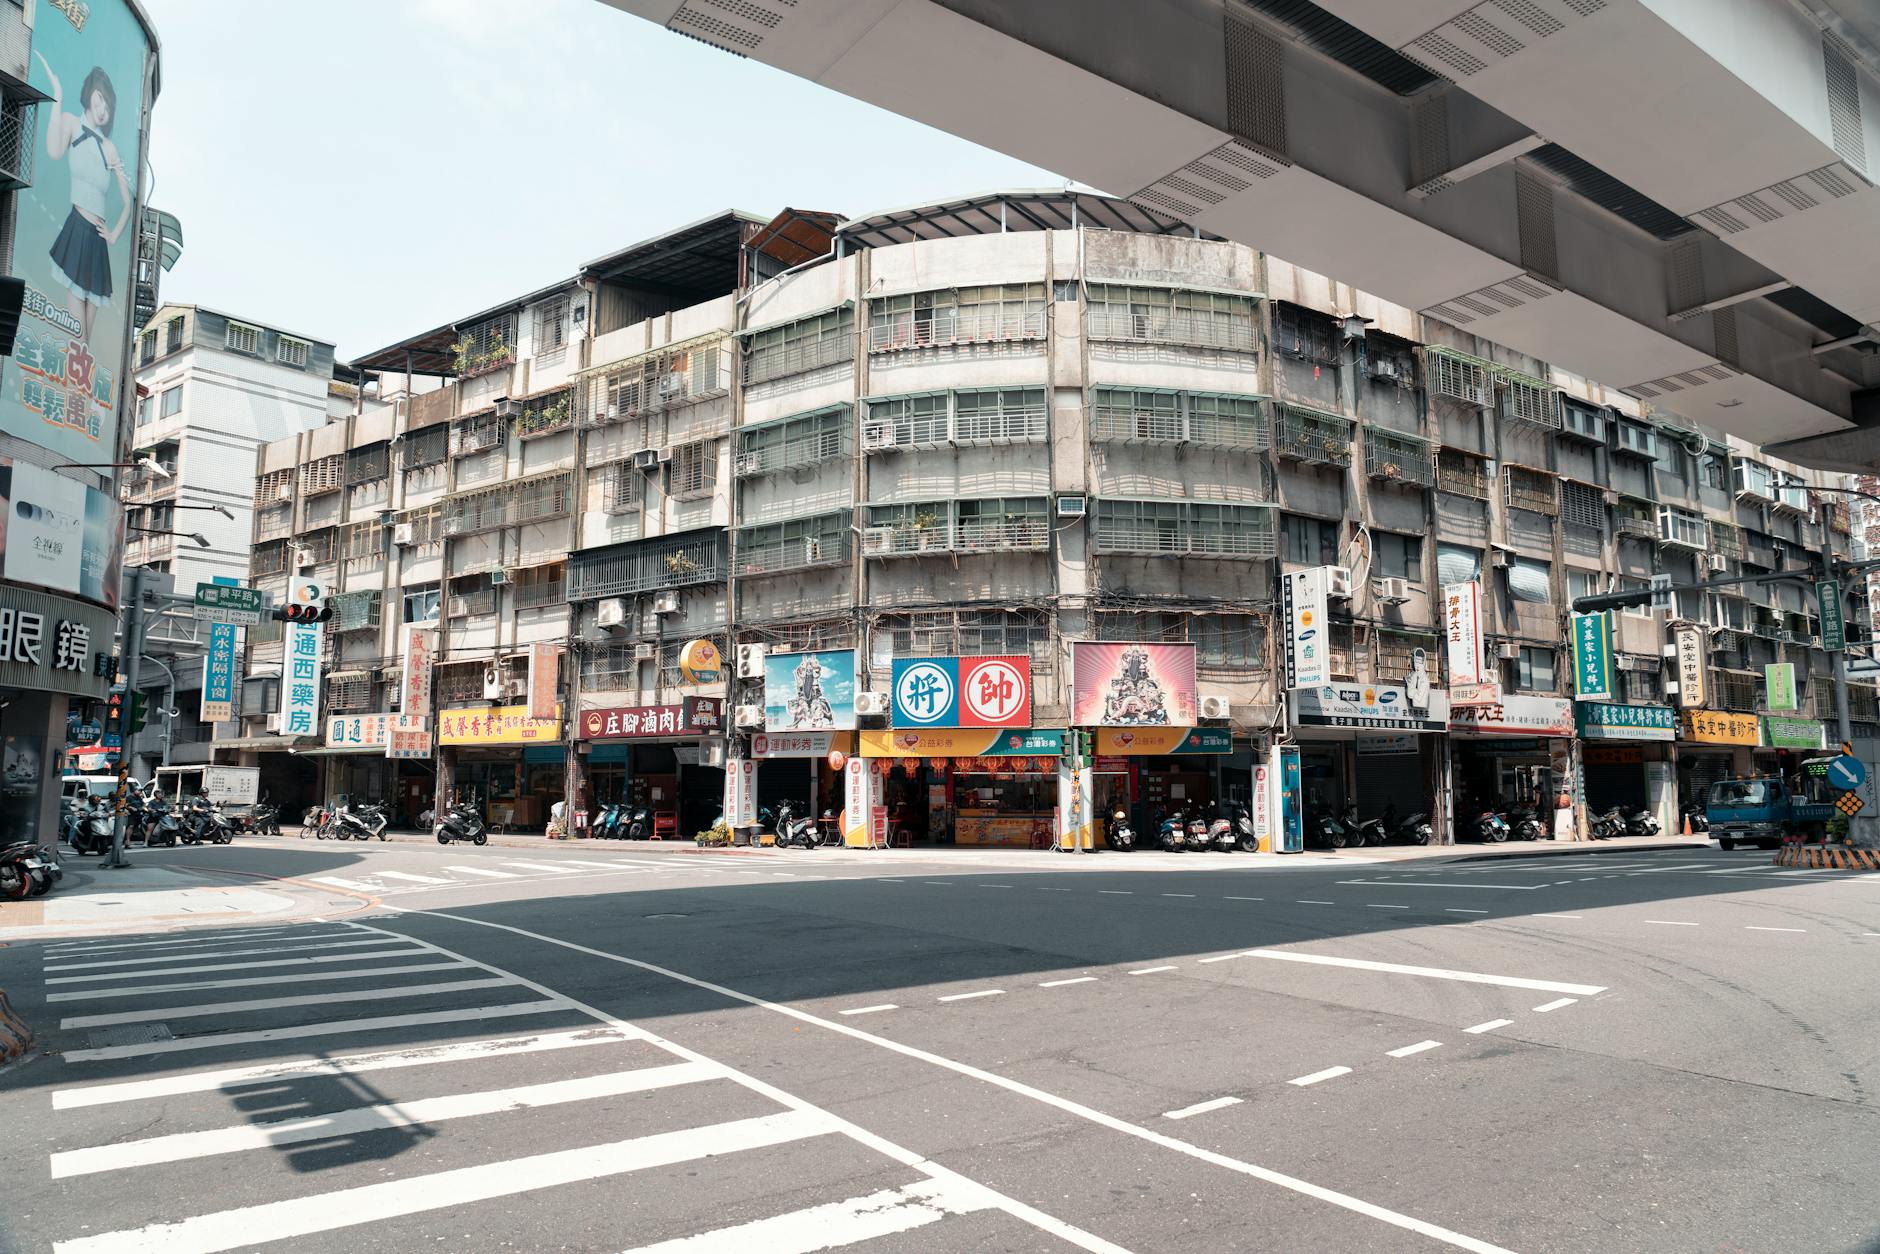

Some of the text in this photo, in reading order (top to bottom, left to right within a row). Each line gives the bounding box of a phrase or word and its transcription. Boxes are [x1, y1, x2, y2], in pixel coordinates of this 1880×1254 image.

[45, 303, 81, 334] Online
[219, 587, 252, 601] 景平路
[1449, 595, 1461, 642] 排骨大王
[0, 608, 90, 673] 眼鏡
[907, 673, 944, 714] 將
[978, 670, 1014, 714] 帥
[1360, 707, 1379, 715] PHILIPS
